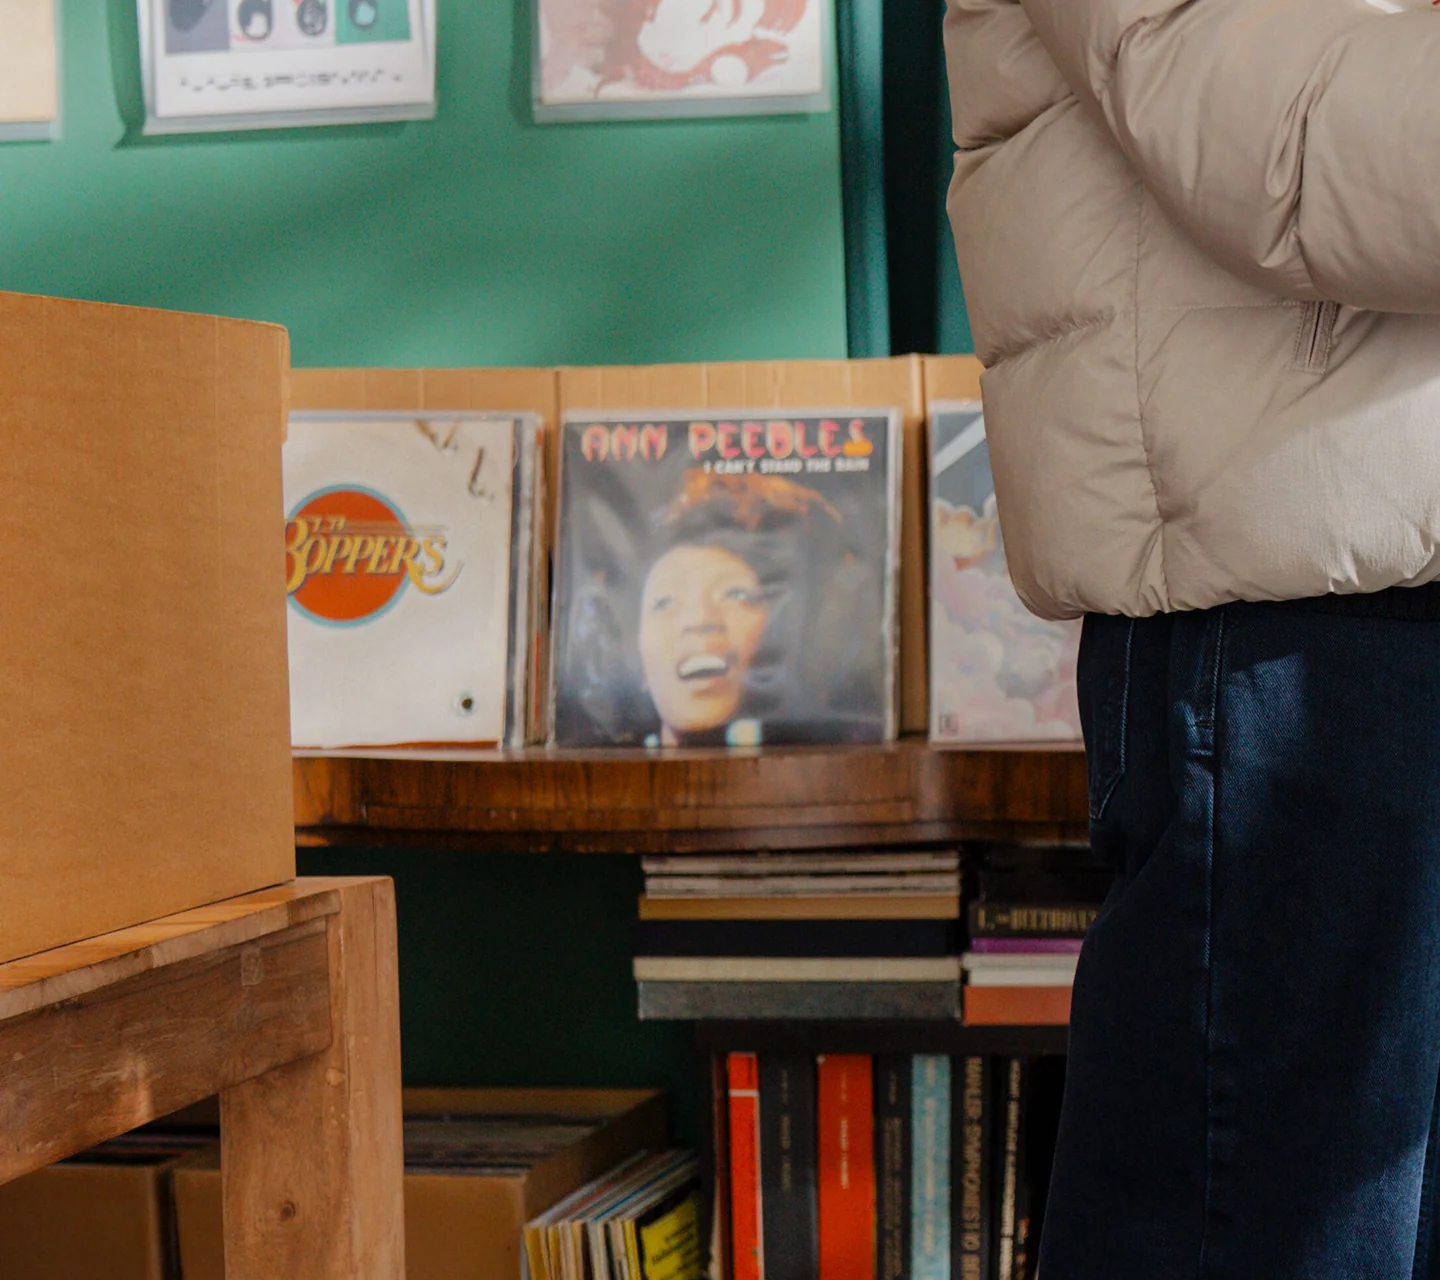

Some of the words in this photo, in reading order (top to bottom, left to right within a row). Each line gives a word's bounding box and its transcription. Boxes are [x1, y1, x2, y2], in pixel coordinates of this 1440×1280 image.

[581, 423, 668, 463] ANN
[688, 419, 874, 460] PEEBLES
[806, 457, 832, 472] THE
